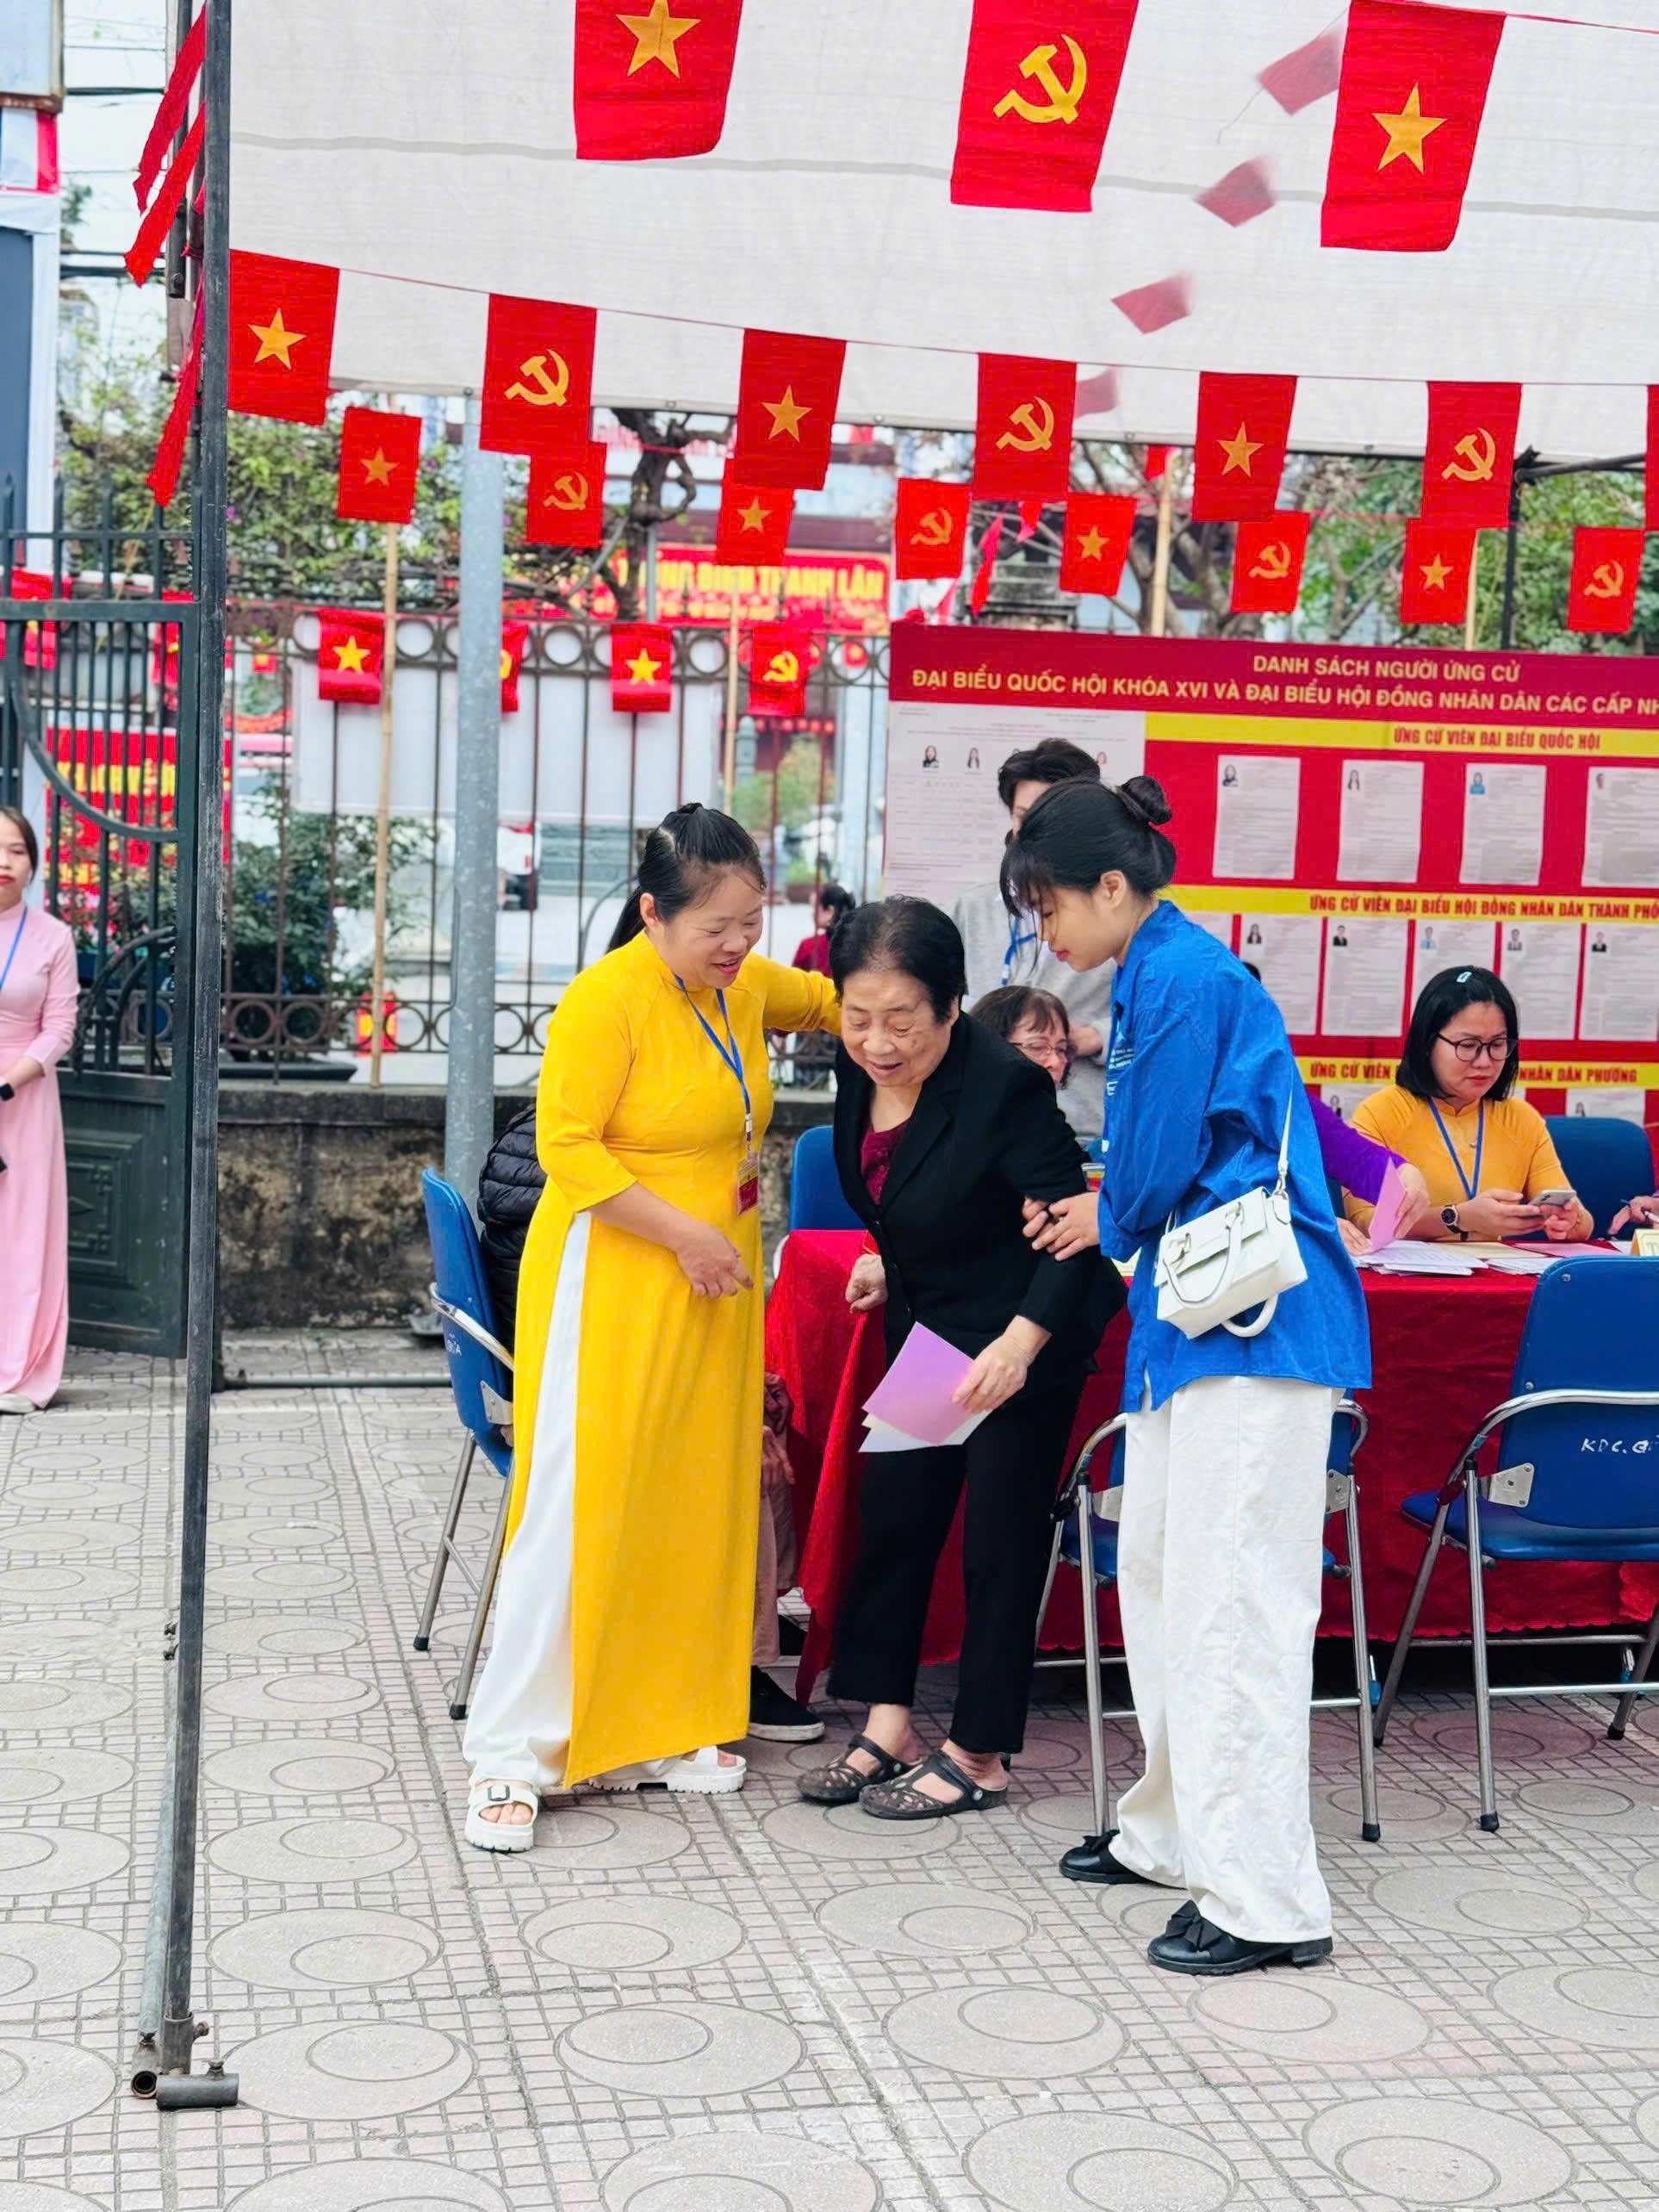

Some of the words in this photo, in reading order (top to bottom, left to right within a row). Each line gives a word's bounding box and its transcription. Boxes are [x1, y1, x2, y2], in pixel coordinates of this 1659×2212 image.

[1253, 656, 1309, 674] DANH
[1314, 656, 1370, 676] SÁCH
[1376, 659, 1438, 680] NGƯỜI
[1444, 660, 1486, 681] ỨNG
[1491, 659, 1521, 682] CỬ
[912, 669, 948, 690] ĐẠI
[953, 663, 1002, 690] BIỂU
[1007, 668, 1066, 693] QUỐC
[1072, 673, 1107, 697] HỘI
[1113, 675, 1170, 697] KHÓA
[1175, 681, 1209, 699] XVI
[1214, 679, 1240, 700] VÀ
[1246, 684, 1279, 705] ĐẠI
[1284, 678, 1332, 705] BIỂU
[1337, 684, 1371, 708] HỘI
[1439, 689, 1494, 710] NHÂN
[1500, 691, 1541, 711] DÂN
[1546, 692, 1588, 714] CÁC
[1592, 691, 1632, 714] CẤP
[1539, 728, 1574, 749] QUỐC
[1578, 732, 1600, 752] HỘI
[1455, 898, 1477, 916] HỘI
